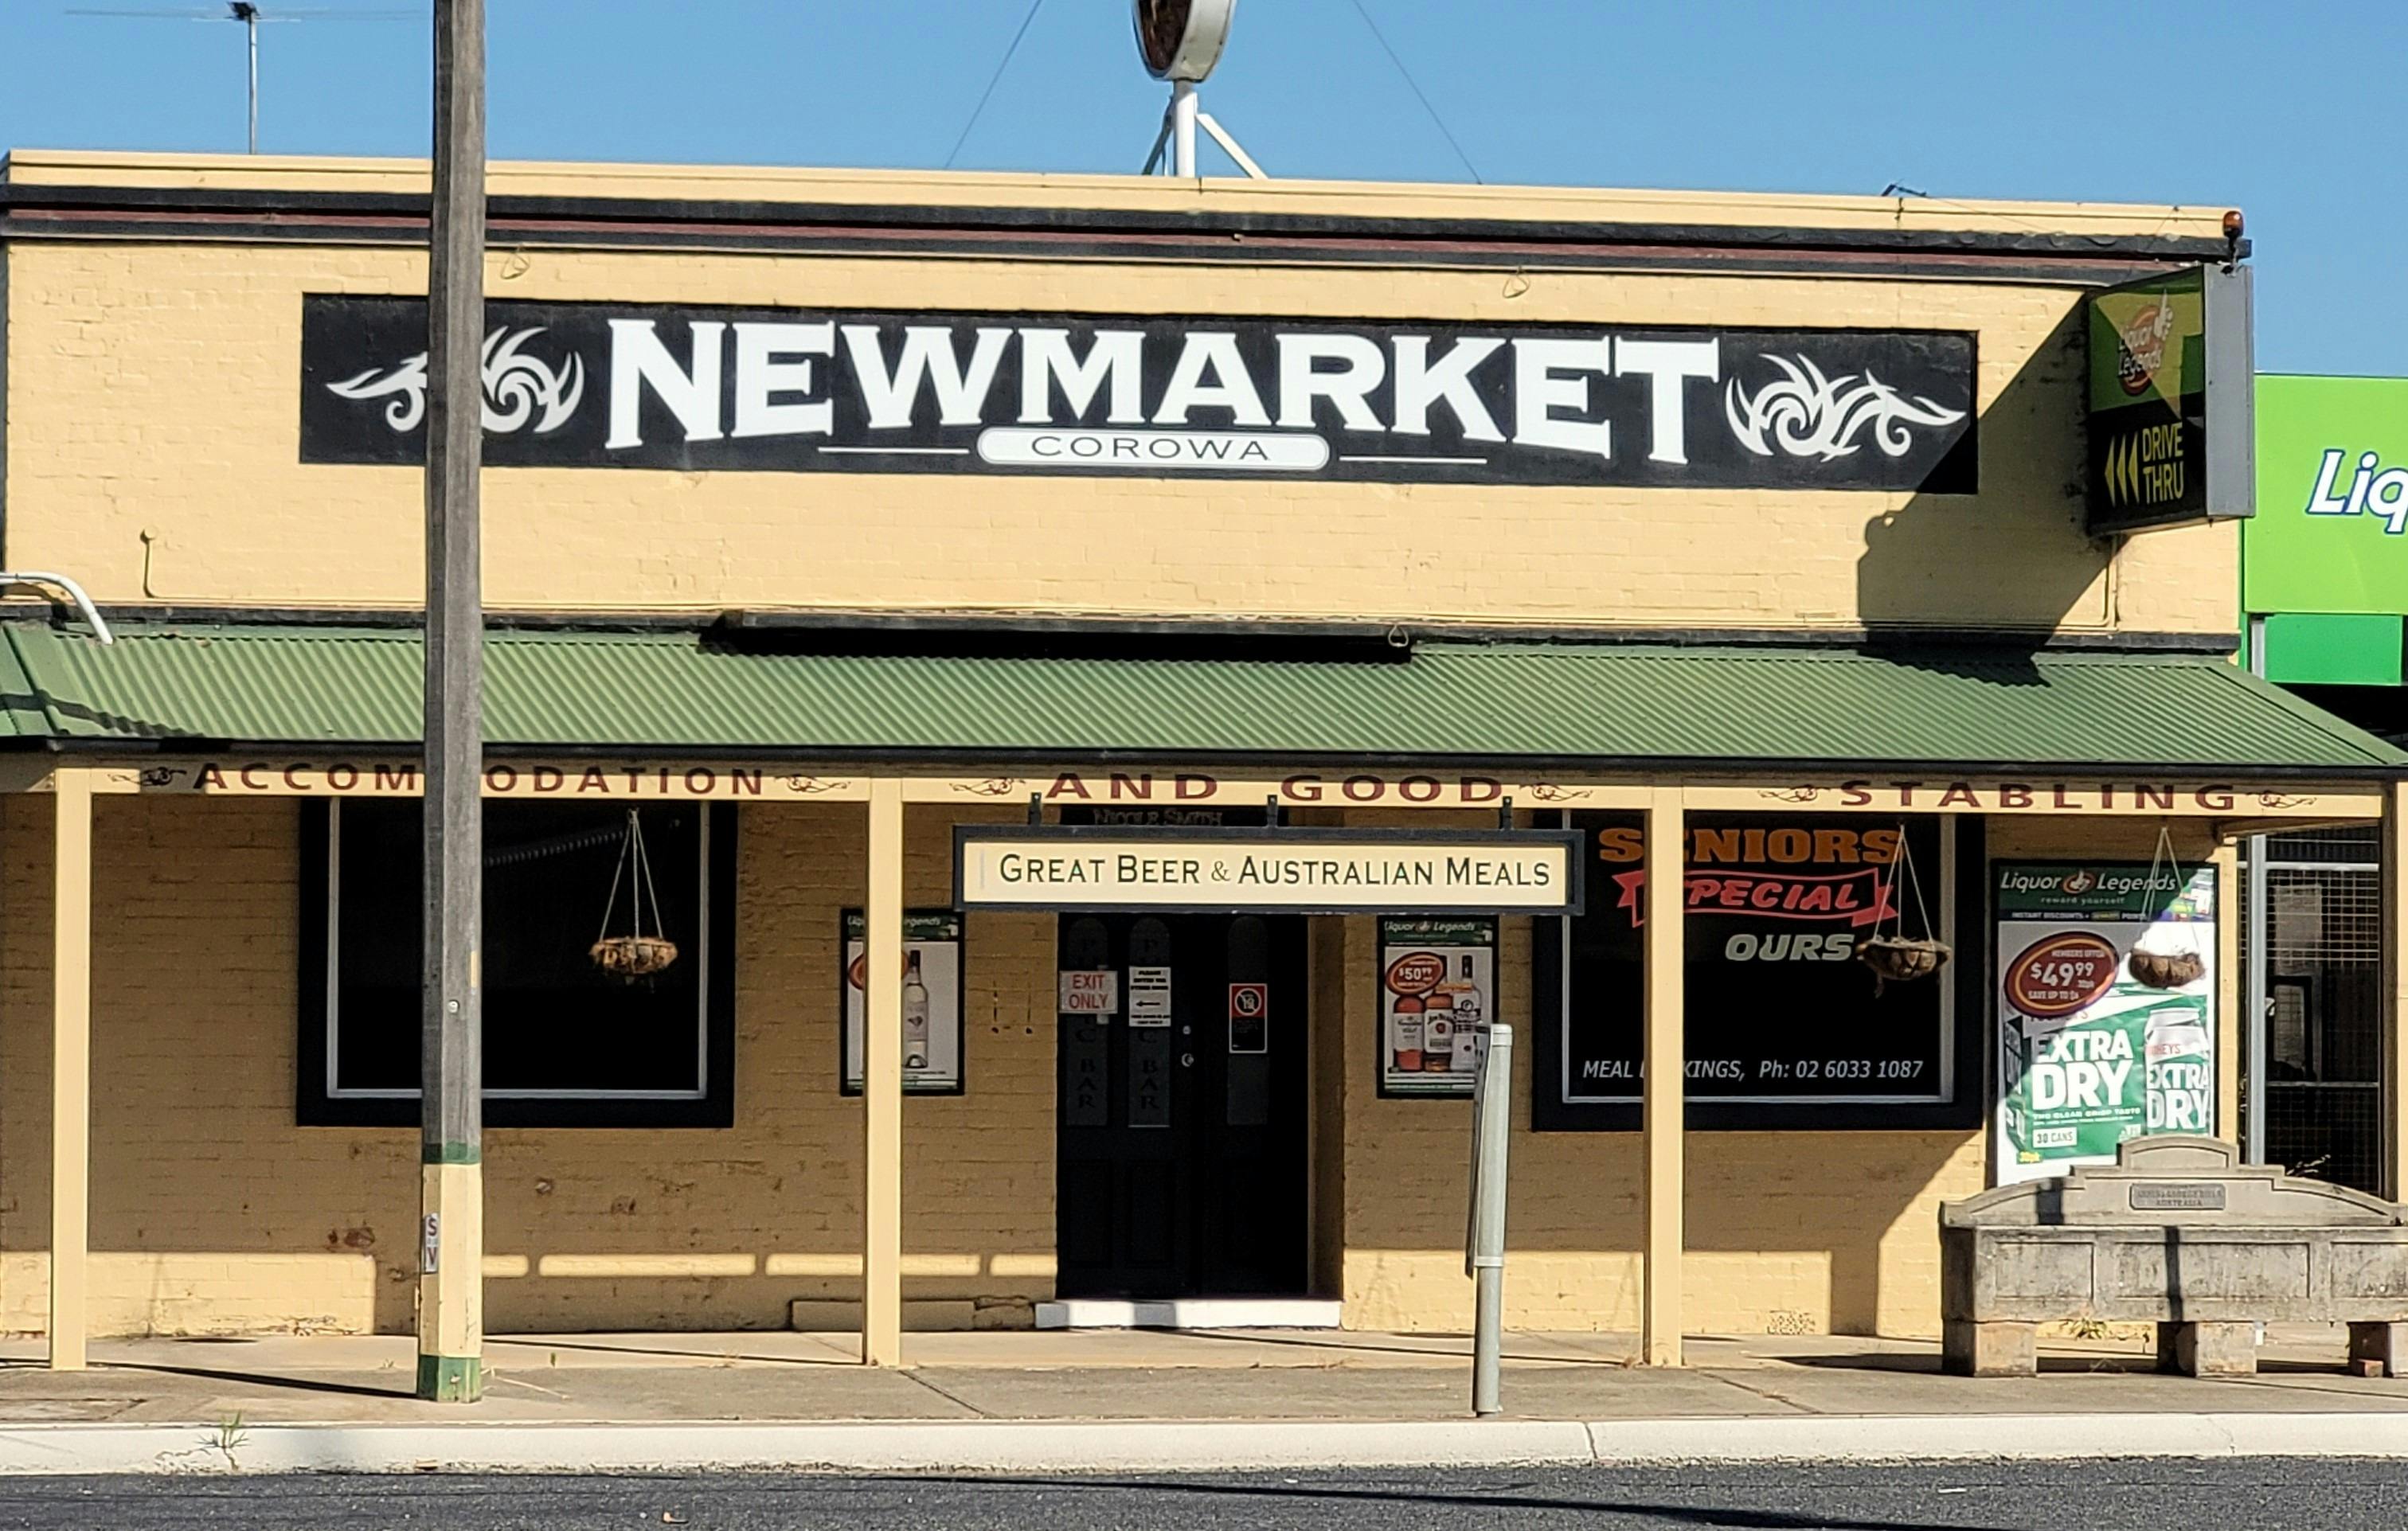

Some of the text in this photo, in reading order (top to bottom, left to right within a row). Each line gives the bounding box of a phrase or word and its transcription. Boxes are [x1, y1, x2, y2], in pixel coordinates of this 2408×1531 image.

[604, 318, 1720, 467] NEWMARKET
[1031, 435, 1272, 461] COROWA
[2142, 422, 2183, 462] DRIVE
[2142, 459, 2184, 504] THRU
[192, 762, 762, 796] ACCOMODATION
[1046, 771, 1503, 803] AND GOOD
[1840, 780, 2234, 810] STABLING
[1597, 827, 1906, 864] SNIORS
[999, 853, 1550, 888] GREAT BEER & AUSTRALIAN MEALS
[2000, 872, 2176, 895] Liquor Legends
[1677, 879, 1860, 912] PECIAL
[1073, 974, 1106, 990] EXIT
[1069, 993, 1109, 1010] ONLY
[2037, 1029, 2134, 1064] EXTRA
[1582, 1060, 1634, 1078] MEAL
[1759, 1060, 1790, 1078] Ph:
[1796, 1060, 1819, 1078] 02
[1824, 1060, 1871, 1079] 6033
[1877, 1060, 1923, 1079] 1087
[2031, 1060, 2134, 1111] DRY
[2148, 1063, 2210, 1089] EXTRA
[2147, 1089, 2209, 1130] DRY
[2050, 1131, 2074, 1143] CANS
